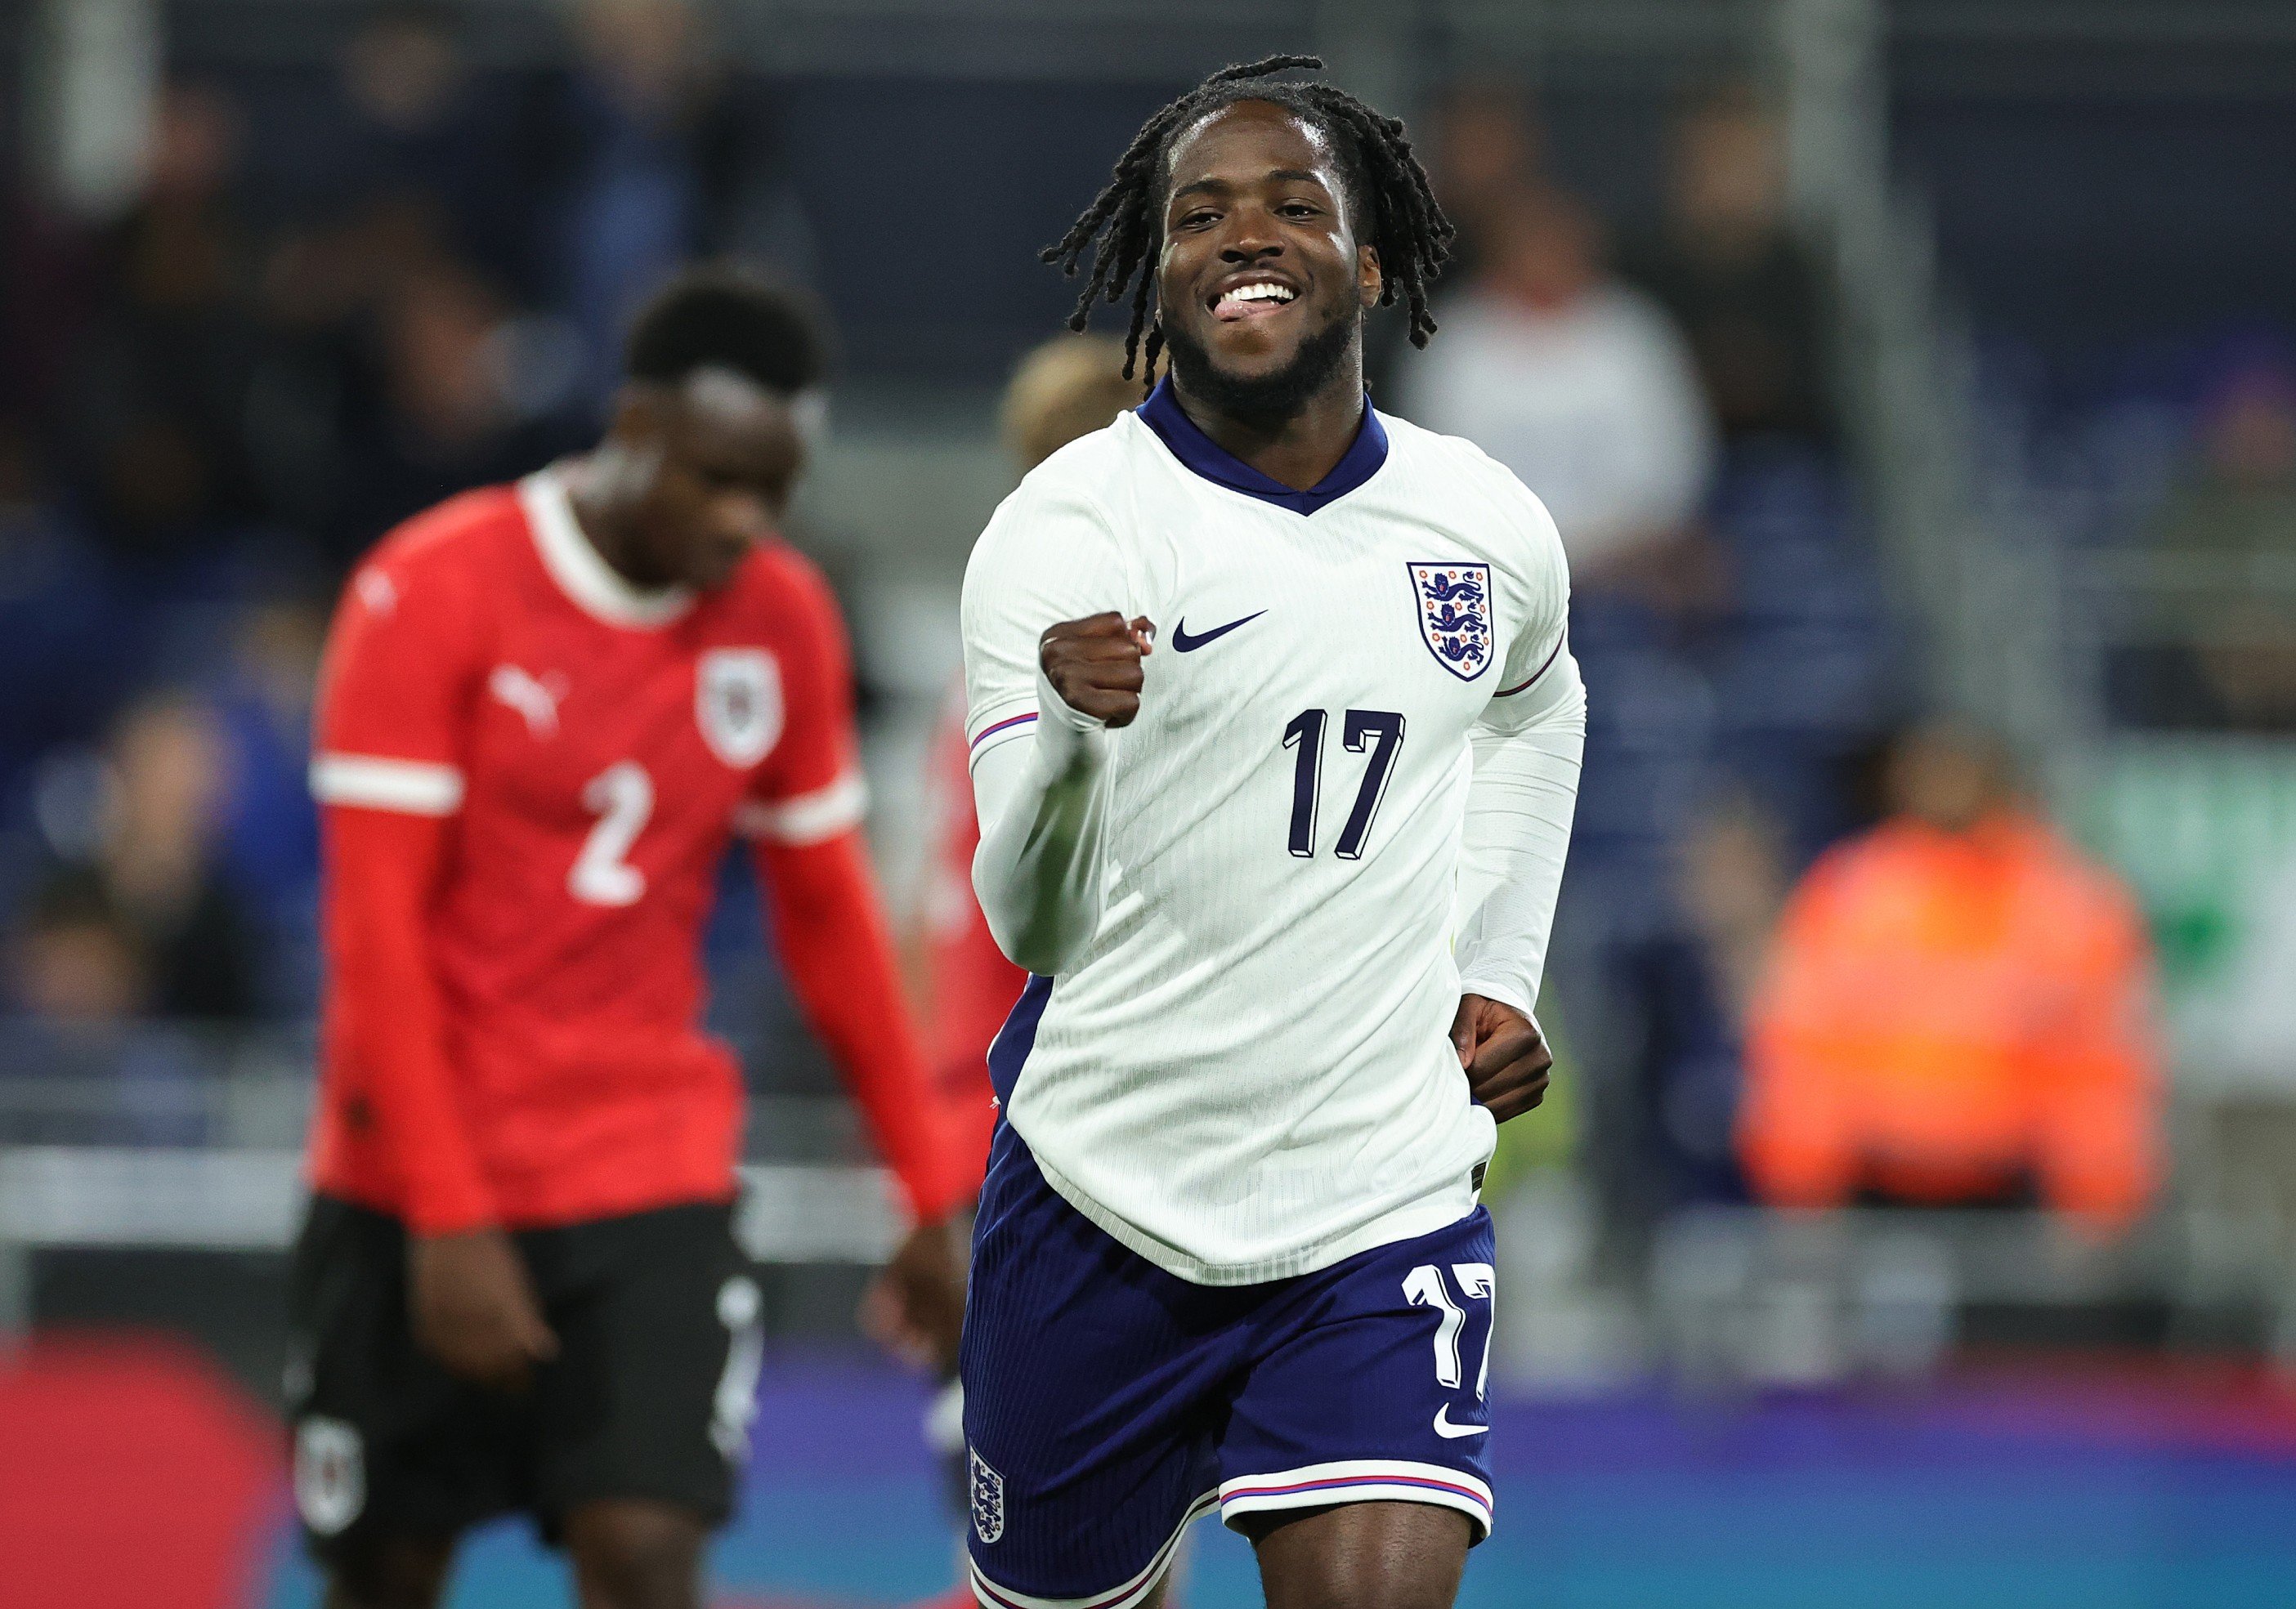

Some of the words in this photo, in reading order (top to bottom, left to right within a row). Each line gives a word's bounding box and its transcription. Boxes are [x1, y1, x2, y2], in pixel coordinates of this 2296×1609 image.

[567, 760, 655, 905] 2
[1282, 708, 1406, 860] 17
[1401, 1263, 1496, 1403] 17
